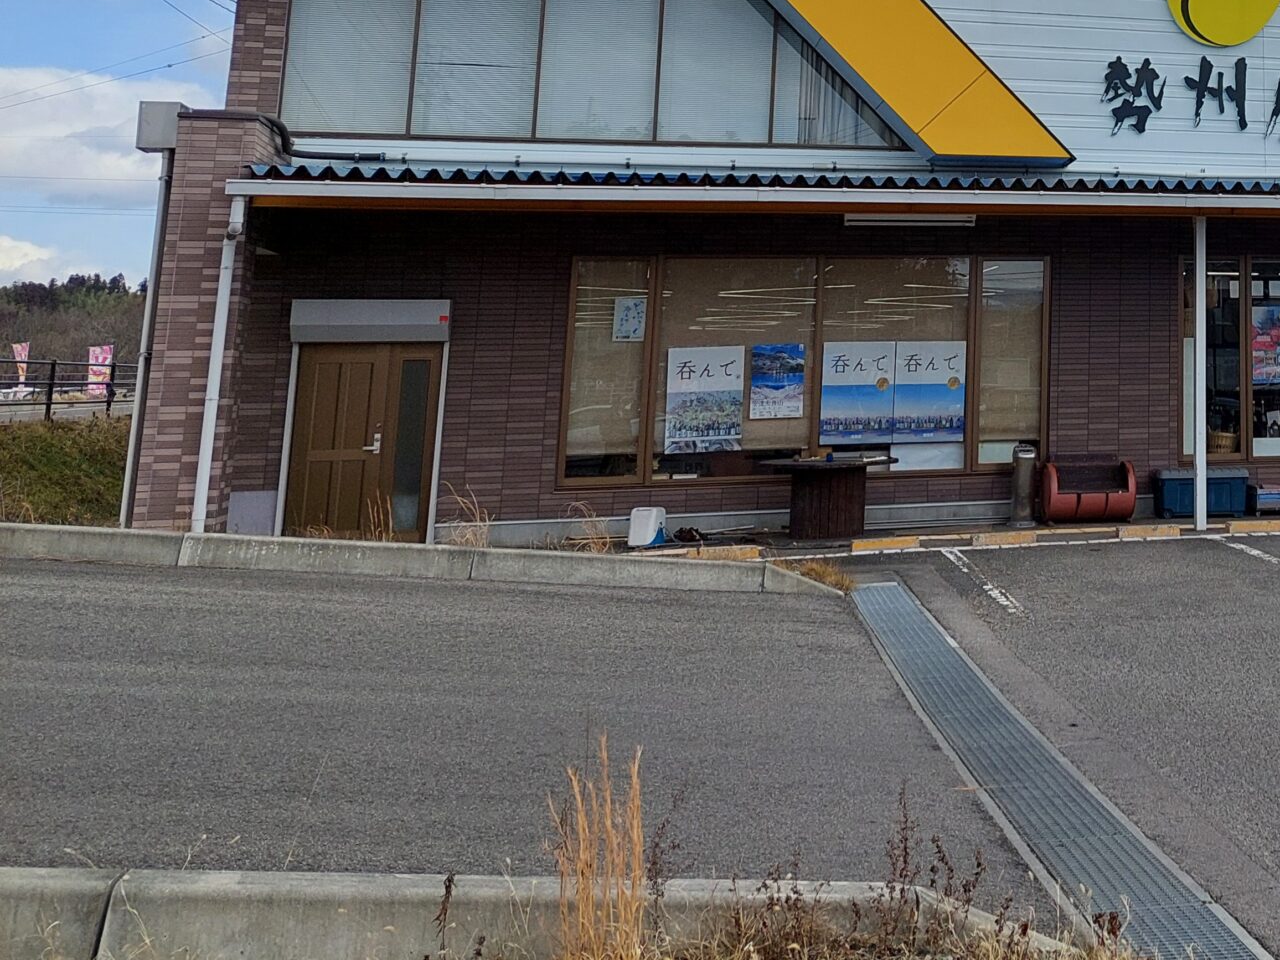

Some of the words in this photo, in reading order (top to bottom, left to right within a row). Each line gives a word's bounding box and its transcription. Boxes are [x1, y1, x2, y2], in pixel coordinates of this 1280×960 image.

[675, 359, 737, 381] 呑んで
[831, 354, 888, 374] 呑んで
[904, 353, 959, 373] 呑んで
